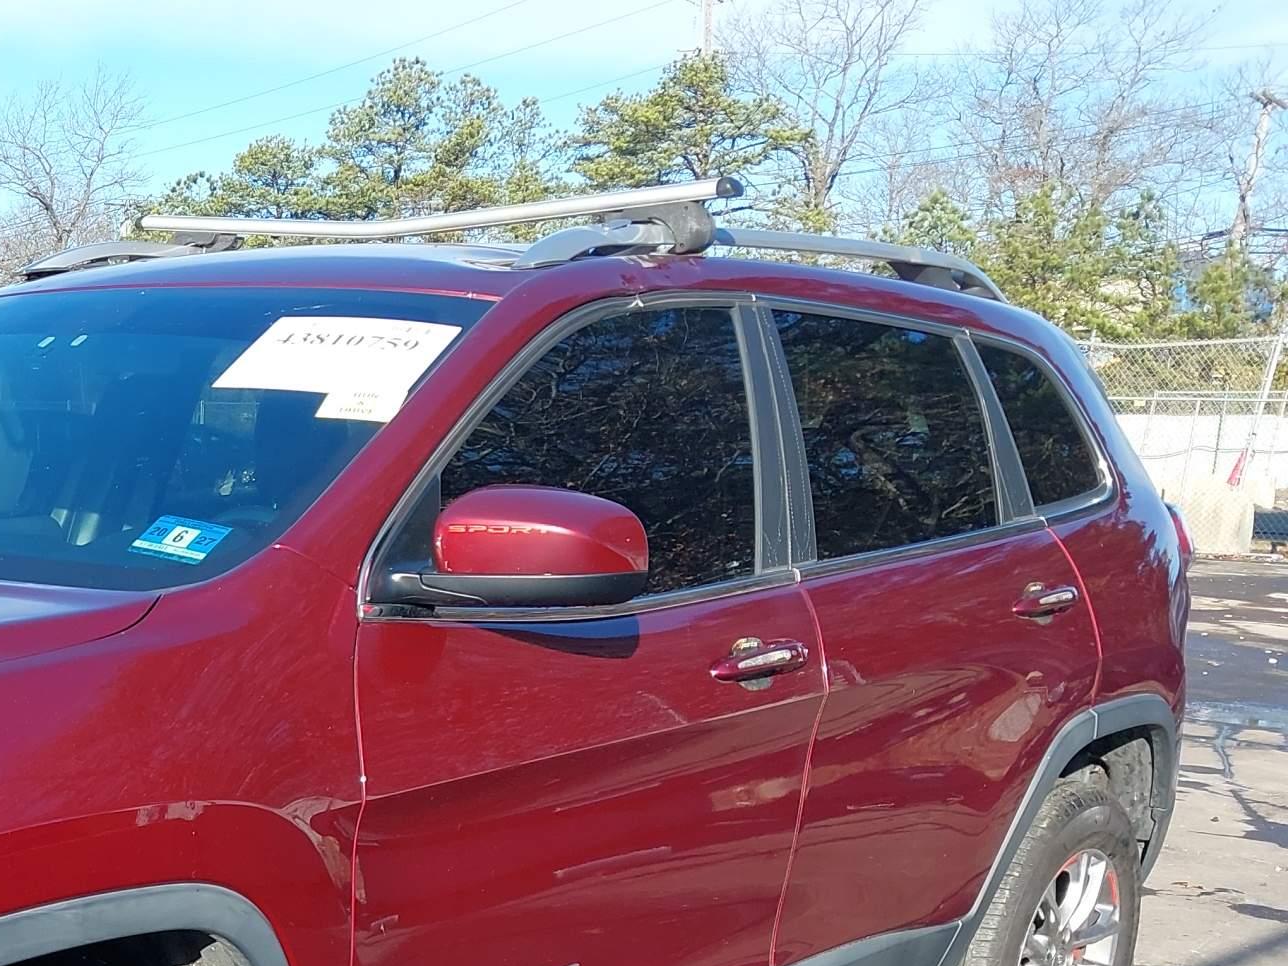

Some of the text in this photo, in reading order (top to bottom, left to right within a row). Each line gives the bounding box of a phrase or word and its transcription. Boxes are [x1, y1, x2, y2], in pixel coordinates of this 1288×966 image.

[276, 332, 421, 351] 43810759
[149, 526, 217, 547] 20 6 27
[448, 523, 549, 535] SPORT
